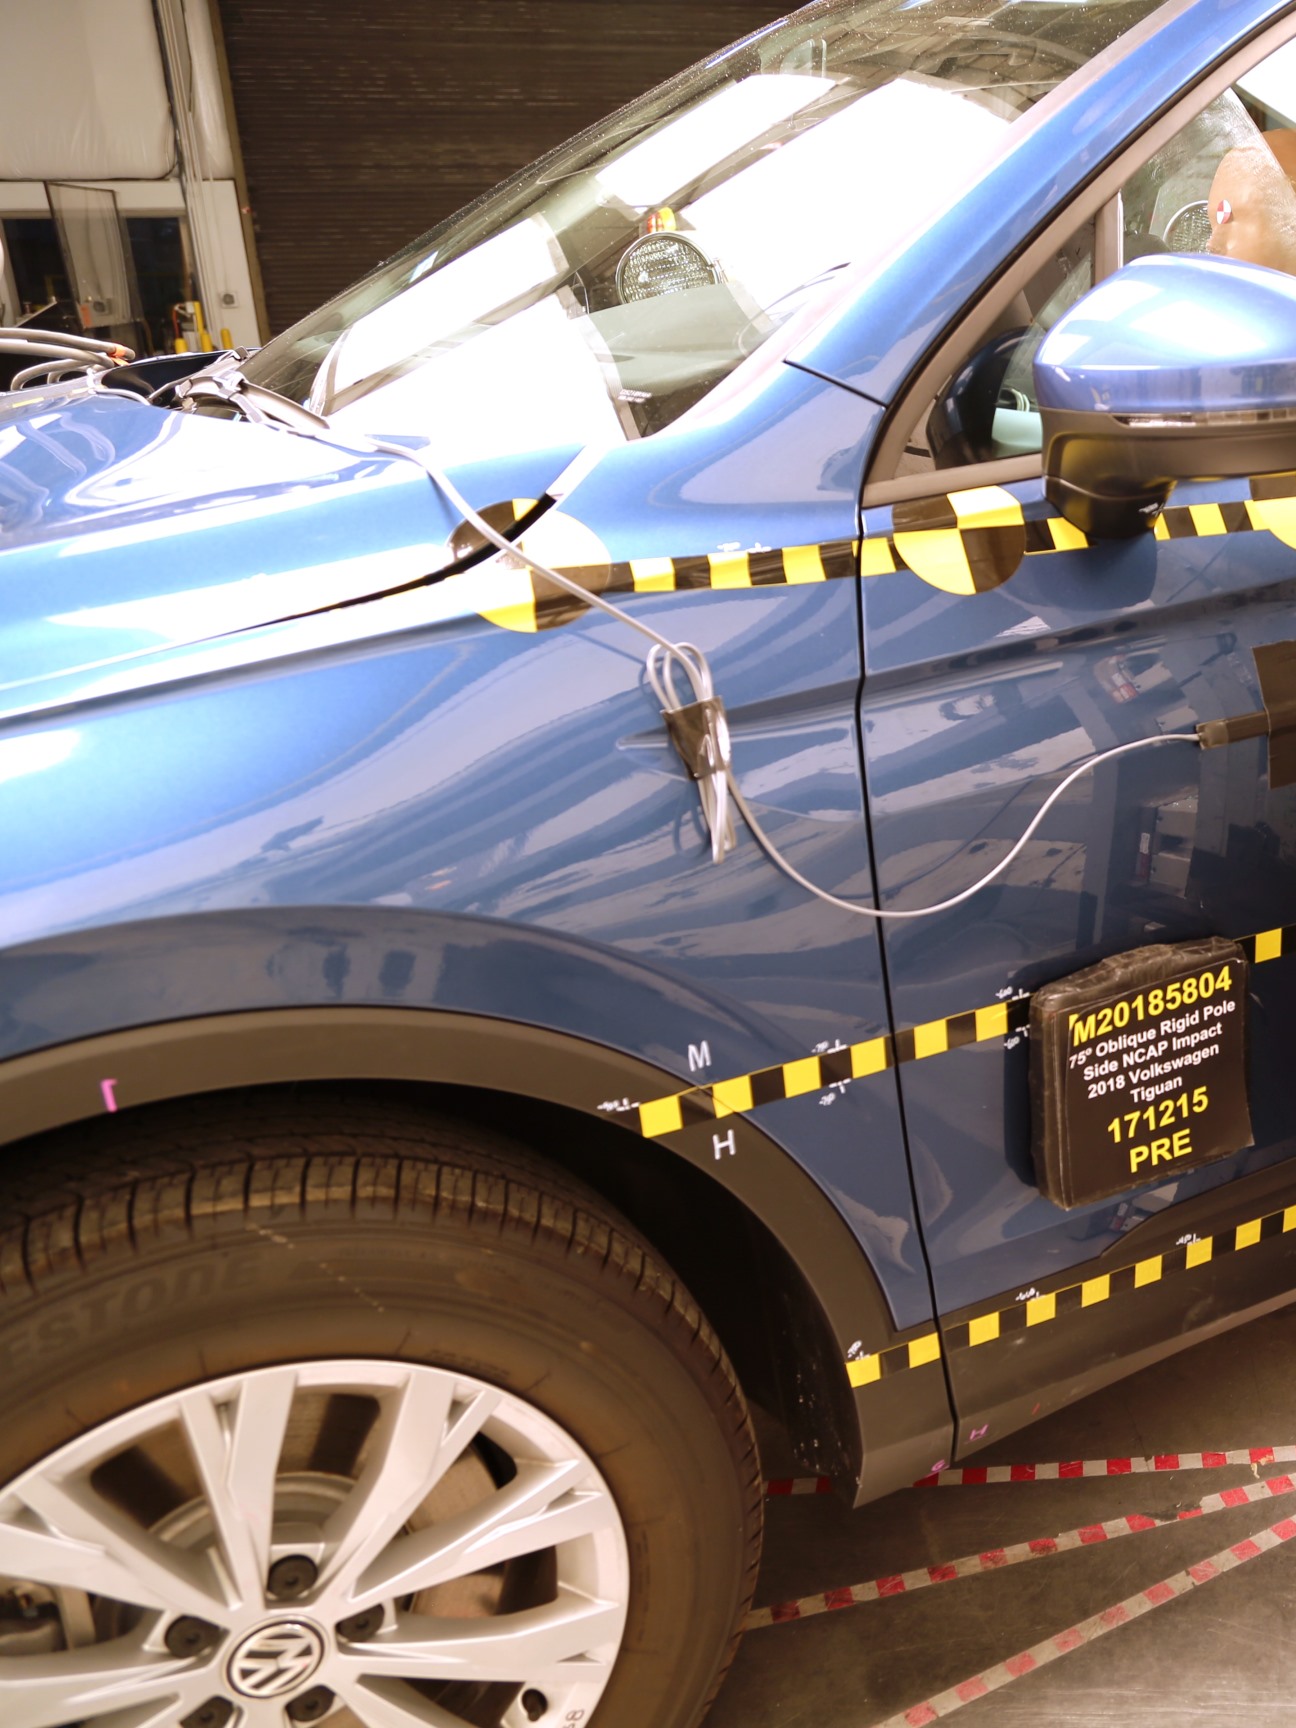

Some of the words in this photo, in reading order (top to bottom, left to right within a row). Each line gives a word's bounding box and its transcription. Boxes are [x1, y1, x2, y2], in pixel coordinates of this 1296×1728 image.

[1073, 966, 1233, 1047] M20185804
[1096, 1029, 1156, 1057] Oblique
[1160, 1010, 1199, 1036] Rigid
[1203, 1000, 1235, 1027] Pole
[687, 1040, 711, 1072] M
[1083, 1060, 1118, 1081] Side
[1122, 1039, 1168, 1066] NCAP
[1172, 1022, 1222, 1051] Impact
[1087, 1076, 1125, 1099] 2018
[1129, 1044, 1220, 1085] Volkswagen
[1107, 1086, 1209, 1143] 171215
[1130, 1076, 1183, 1103] Tiguan
[712, 1129, 736, 1160] H
[1129, 1128, 1193, 1174] PRE
